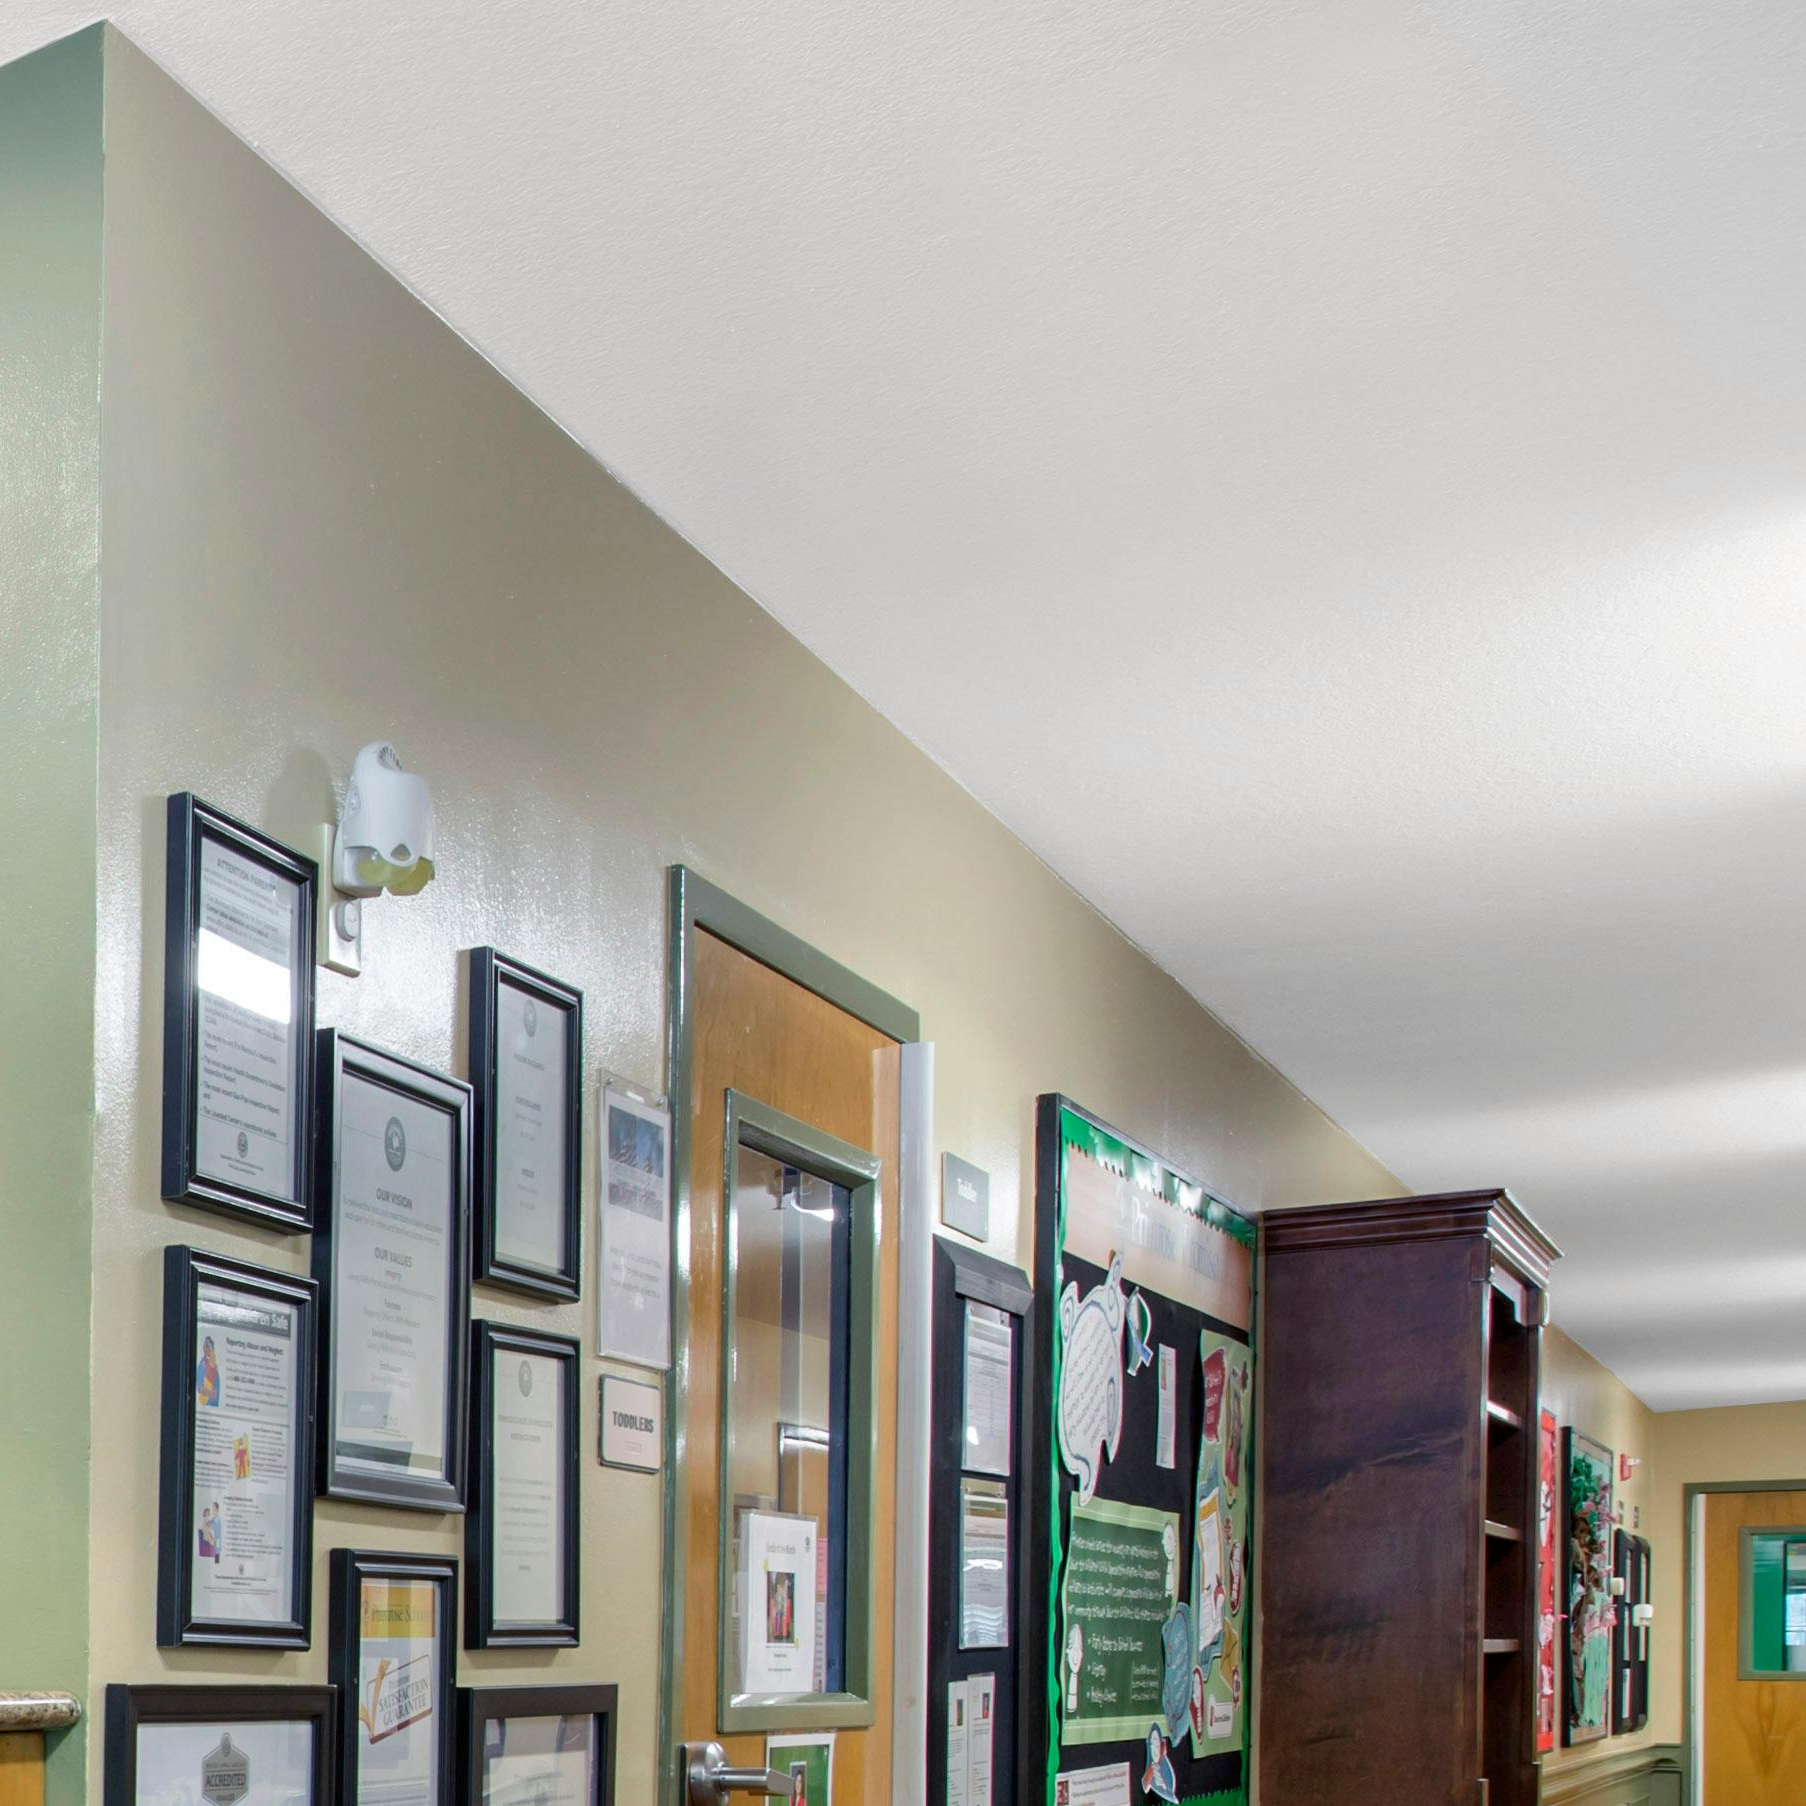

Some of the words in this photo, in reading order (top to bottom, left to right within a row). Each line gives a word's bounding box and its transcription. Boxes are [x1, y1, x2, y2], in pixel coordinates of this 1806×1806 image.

[612, 1411, 654, 1433] TODDLERS
[379, 1677, 429, 1713] SATISFACTION
[383, 1696, 427, 1727] GUARANTEE
[205, 1773, 246, 1787] ACCREDITED
